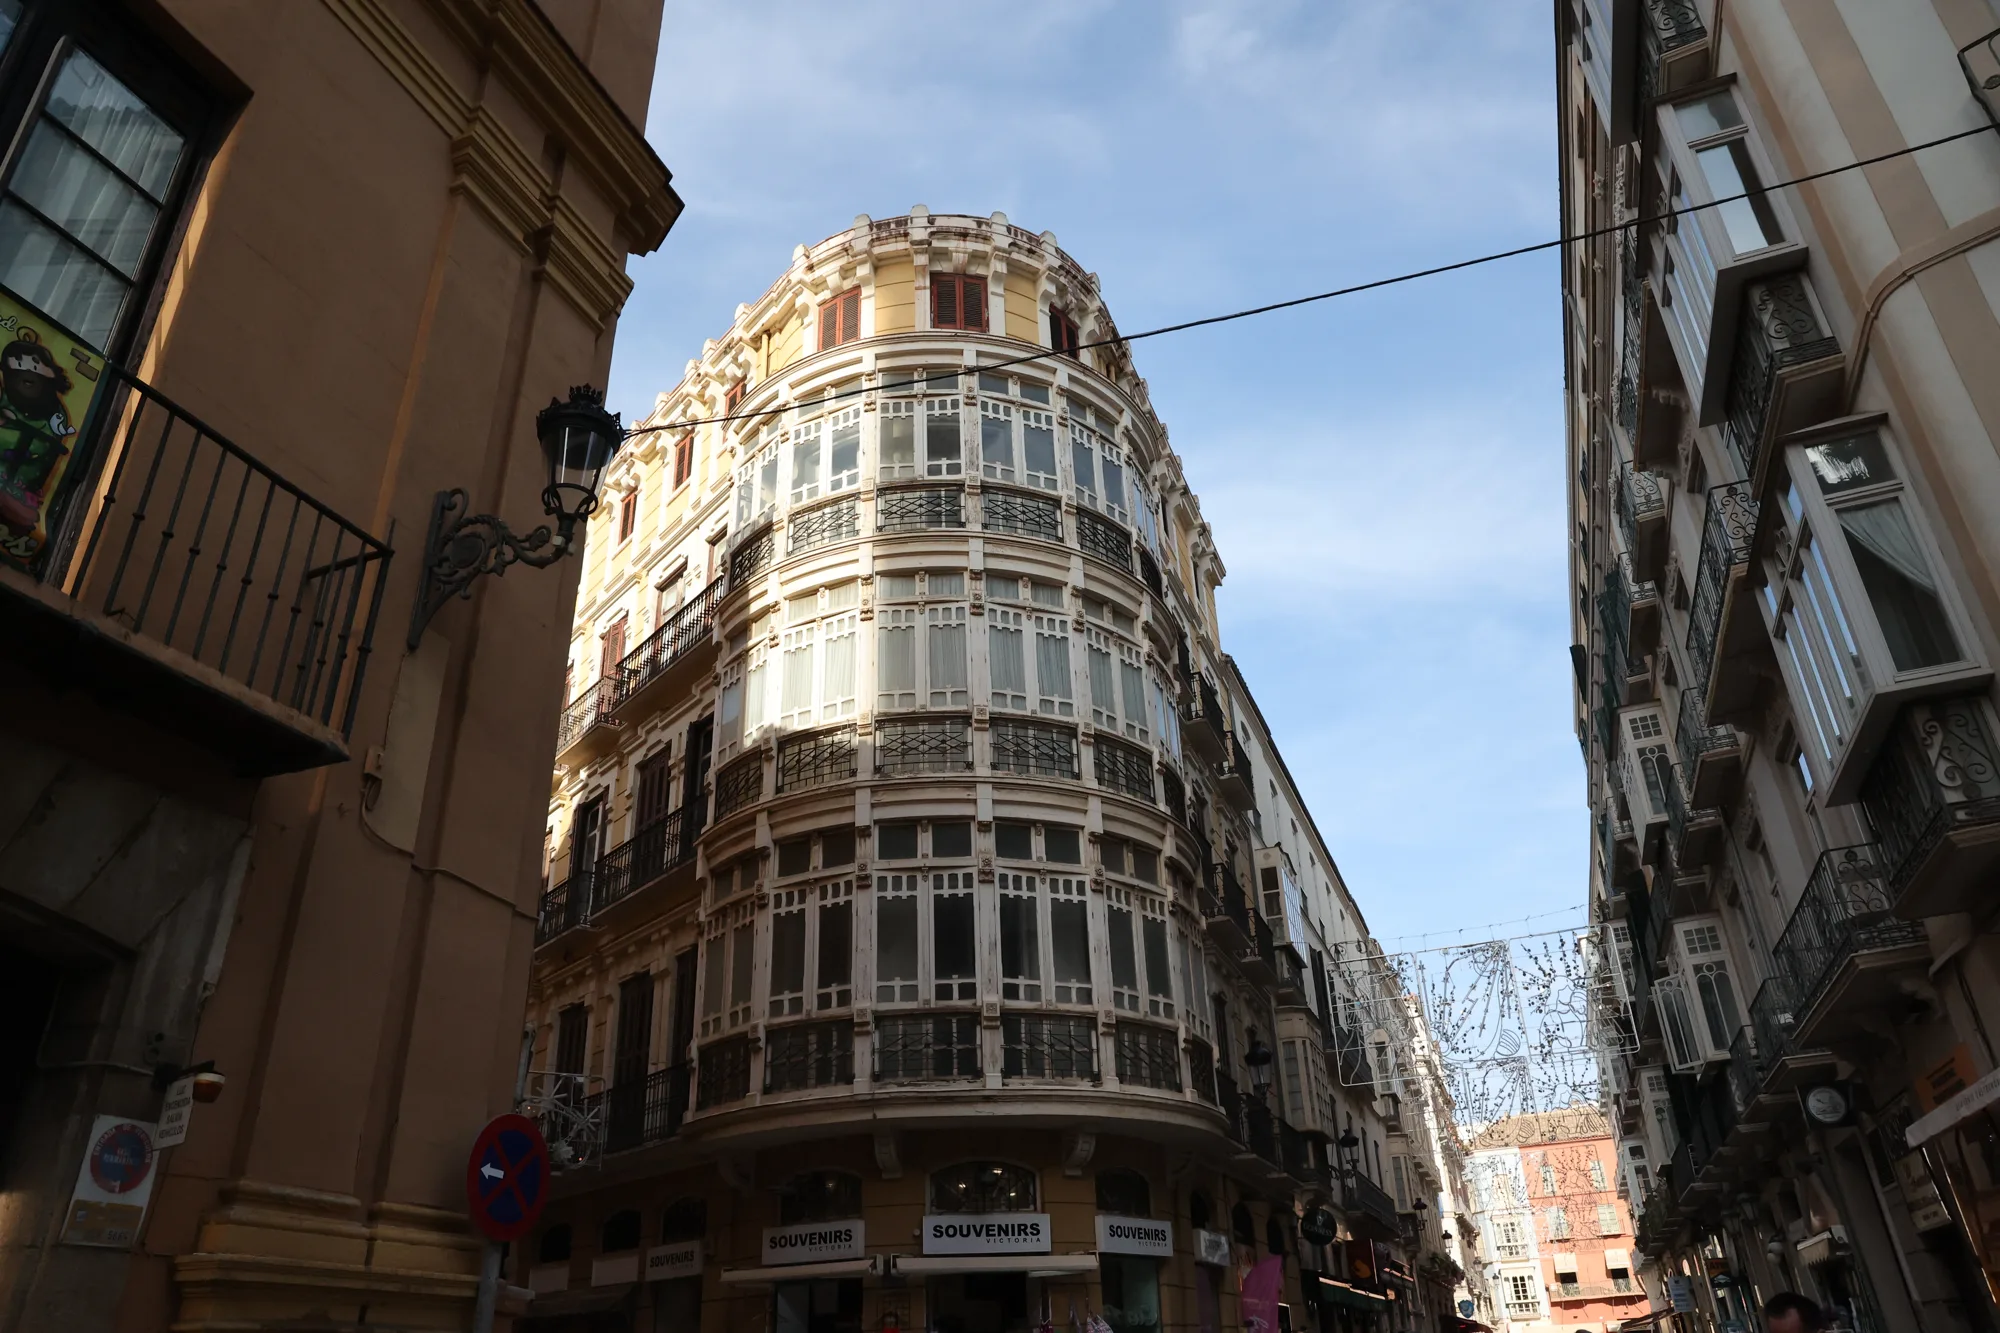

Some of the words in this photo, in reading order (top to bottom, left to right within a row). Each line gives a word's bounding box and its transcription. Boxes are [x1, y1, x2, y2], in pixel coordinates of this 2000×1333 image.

[92, 1127, 116, 1156] ENTRADA
[769, 1229, 853, 1250] SOUVENIRS
[932, 1222, 1041, 1239] SOUVENIRS
[1108, 1224, 1167, 1242] SOUVENIRS
[808, 1243, 853, 1253] VICTORIA
[1138, 1240, 1168, 1248] VICTORIA
[649, 1249, 695, 1268] SOUVENIRS
